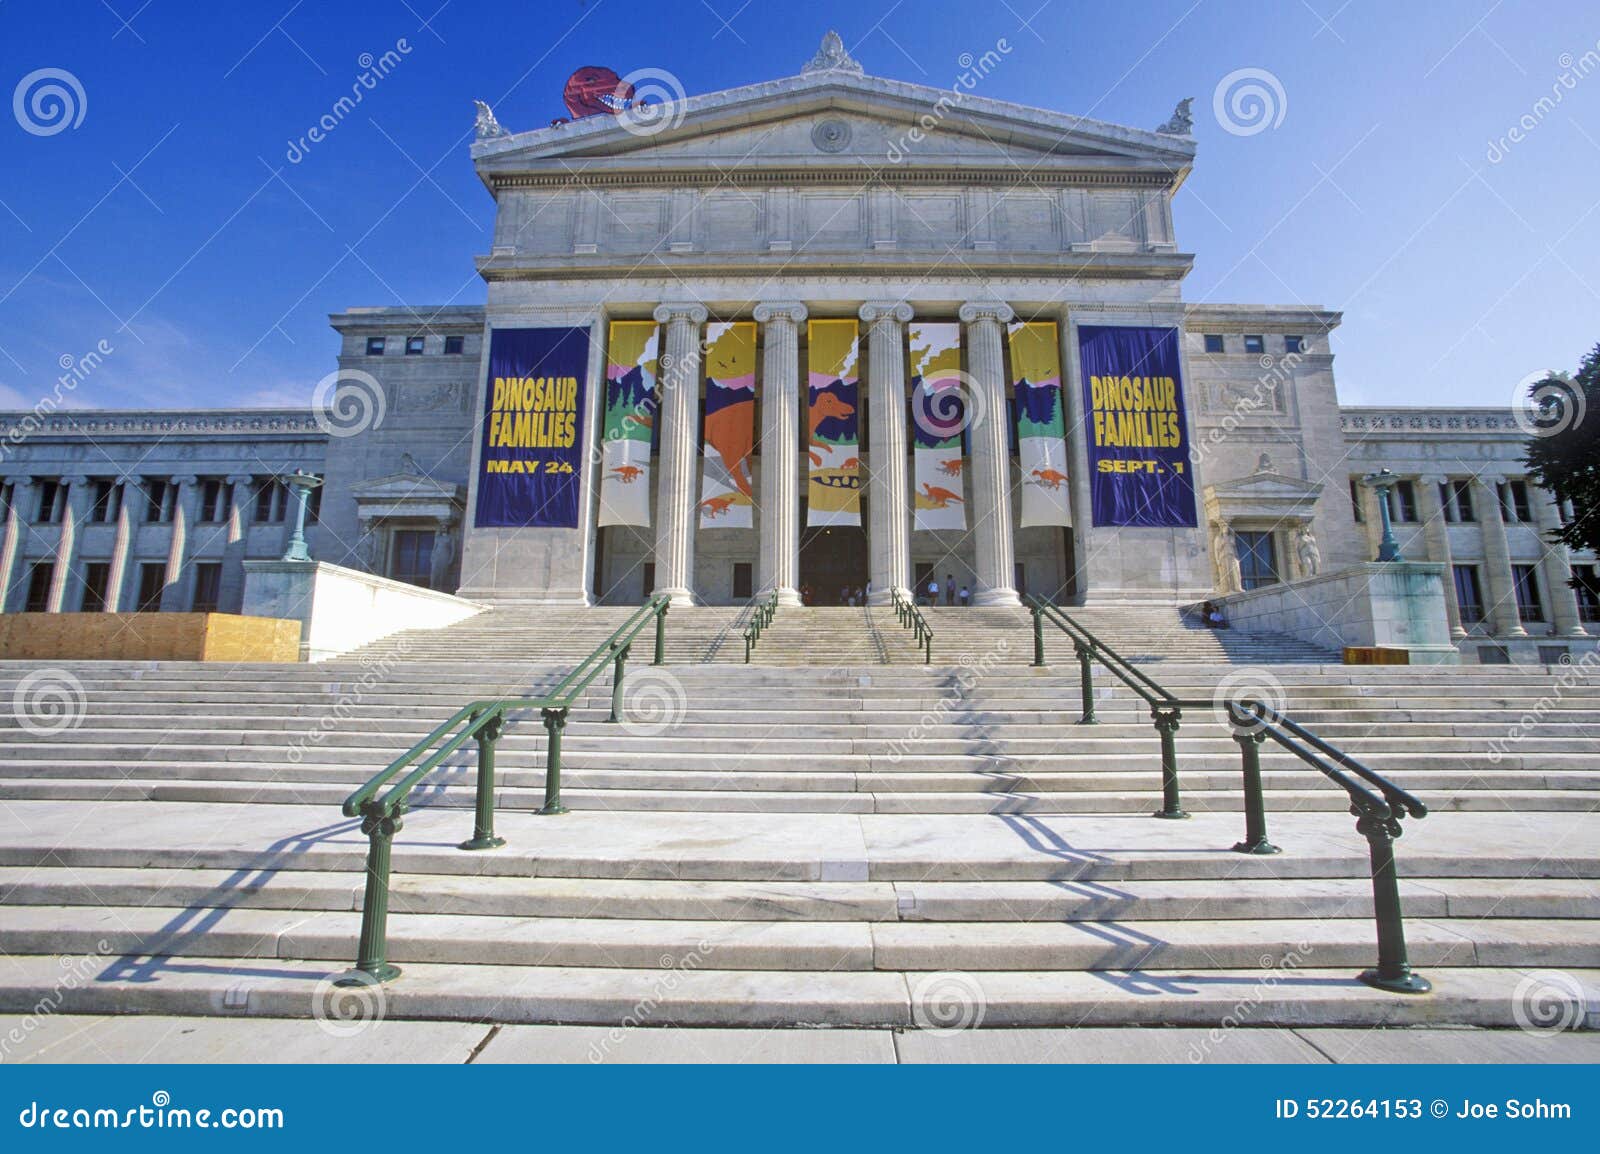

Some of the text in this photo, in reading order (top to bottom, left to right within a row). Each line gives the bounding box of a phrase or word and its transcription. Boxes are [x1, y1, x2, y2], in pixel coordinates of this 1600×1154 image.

[492, 377, 577, 411] DINOSAUR
[1090, 375, 1177, 411] DINOSAUR
[488, 411, 576, 448] FAMILIES
[1093, 411, 1180, 448] FAMILIES
[486, 460, 573, 473] MAY 24
[1097, 459, 1184, 473] SEPT. 1
